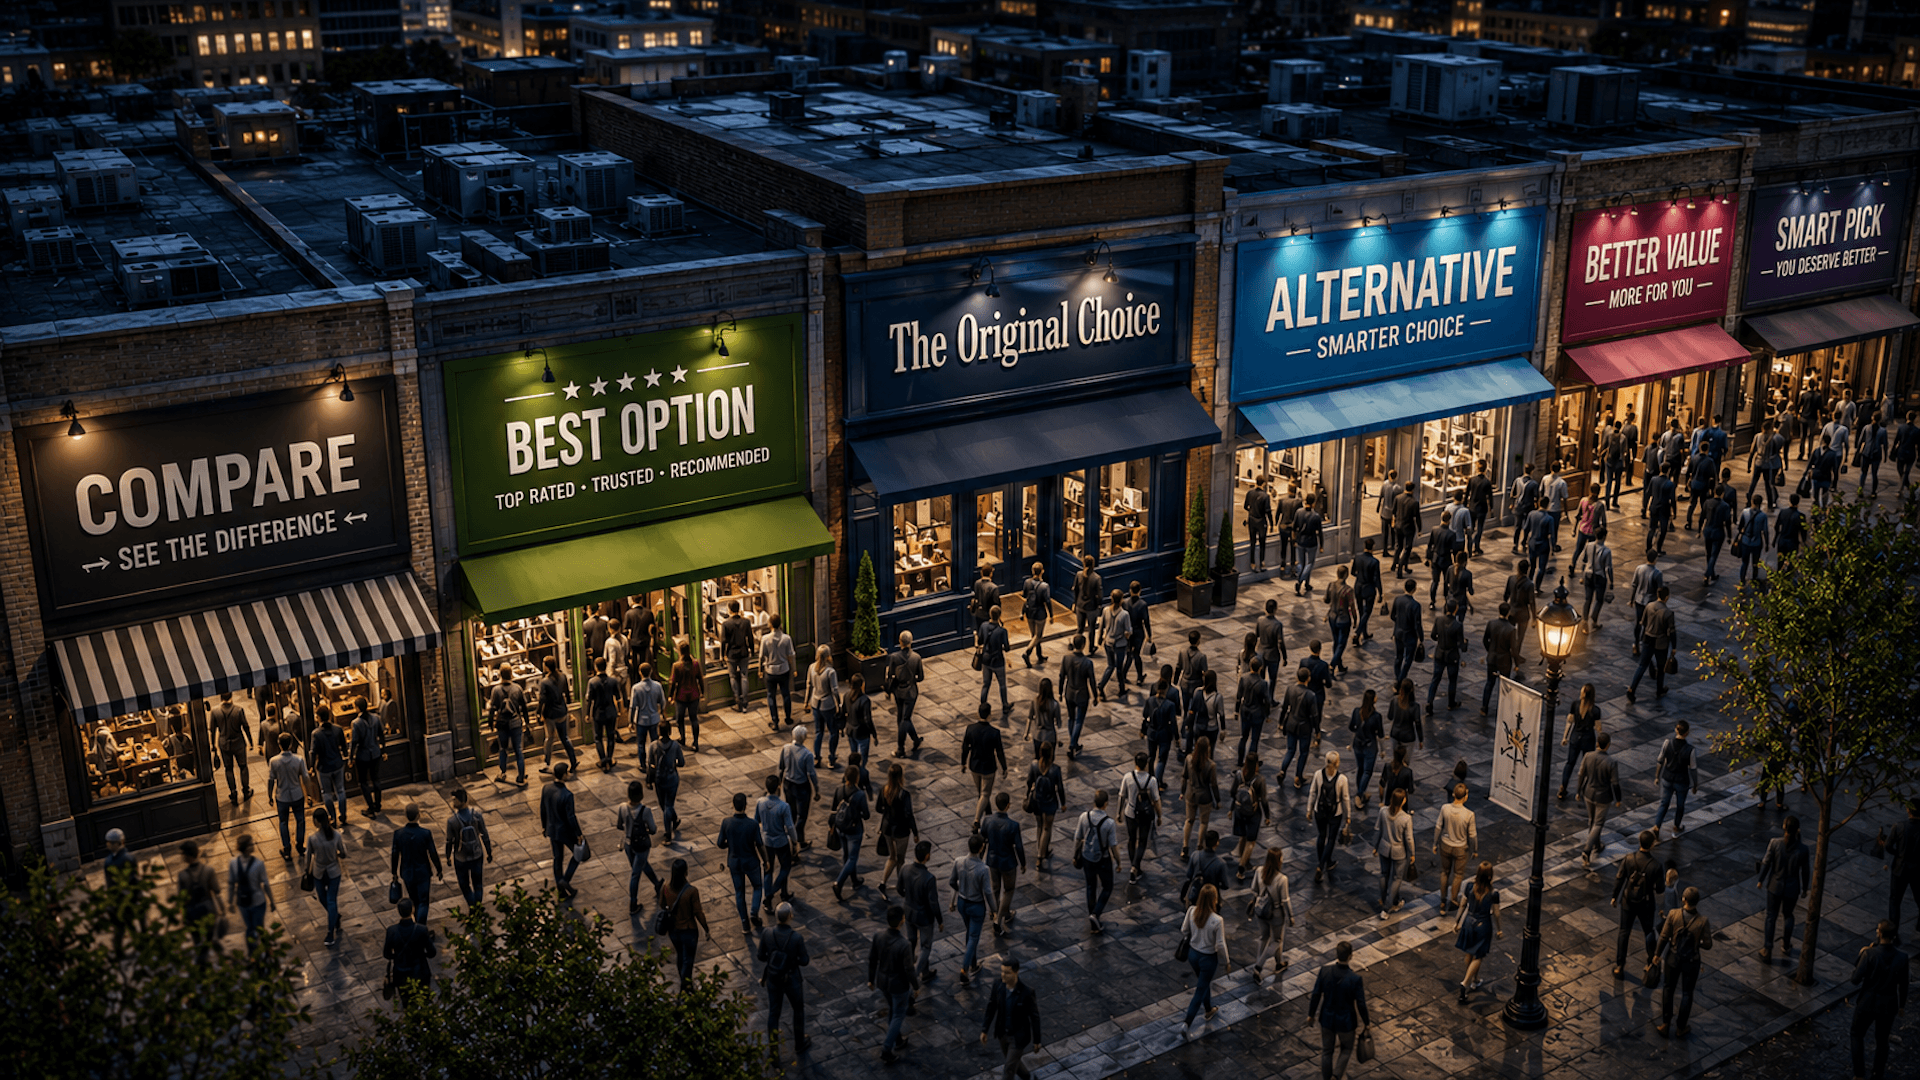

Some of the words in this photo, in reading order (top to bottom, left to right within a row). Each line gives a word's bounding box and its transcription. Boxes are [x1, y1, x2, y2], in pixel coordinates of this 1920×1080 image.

[1585, 237, 1660, 283] BETTER
[1667, 226, 1722, 269] VALUE
[1776, 208, 1841, 251] SMART
[1844, 204, 1885, 241] PICK
[1265, 245, 1516, 333] ALTERNATIVE
[1777, 259, 1796, 277] YOU
[1798, 252, 1841, 274] DESERVE
[1842, 246, 1877, 266] BETTER
[1609, 286, 1643, 309] MORE
[1646, 282, 1668, 302] FOR
[1672, 278, 1693, 298] YOU
[890, 320, 947, 373] The
[958, 300, 1069, 367] Original
[1077, 291, 1160, 344] Choice
[1317, 325, 1399, 358] SMARTER
[1406, 314, 1465, 343] CHOICE
[507, 407, 605, 475] BEST
[620, 384, 756, 456] OPTION
[75, 433, 361, 537] COMPARE
[495, 491, 524, 510] TOP
[530, 482, 575, 504] RATED
[591, 468, 654, 492] TRUSTED
[670, 447, 769, 478] RECOMMENDED
[118, 542, 160, 570] SEE
[165, 533, 208, 561] THE
[215, 510, 337, 553] DIFFERENCE
